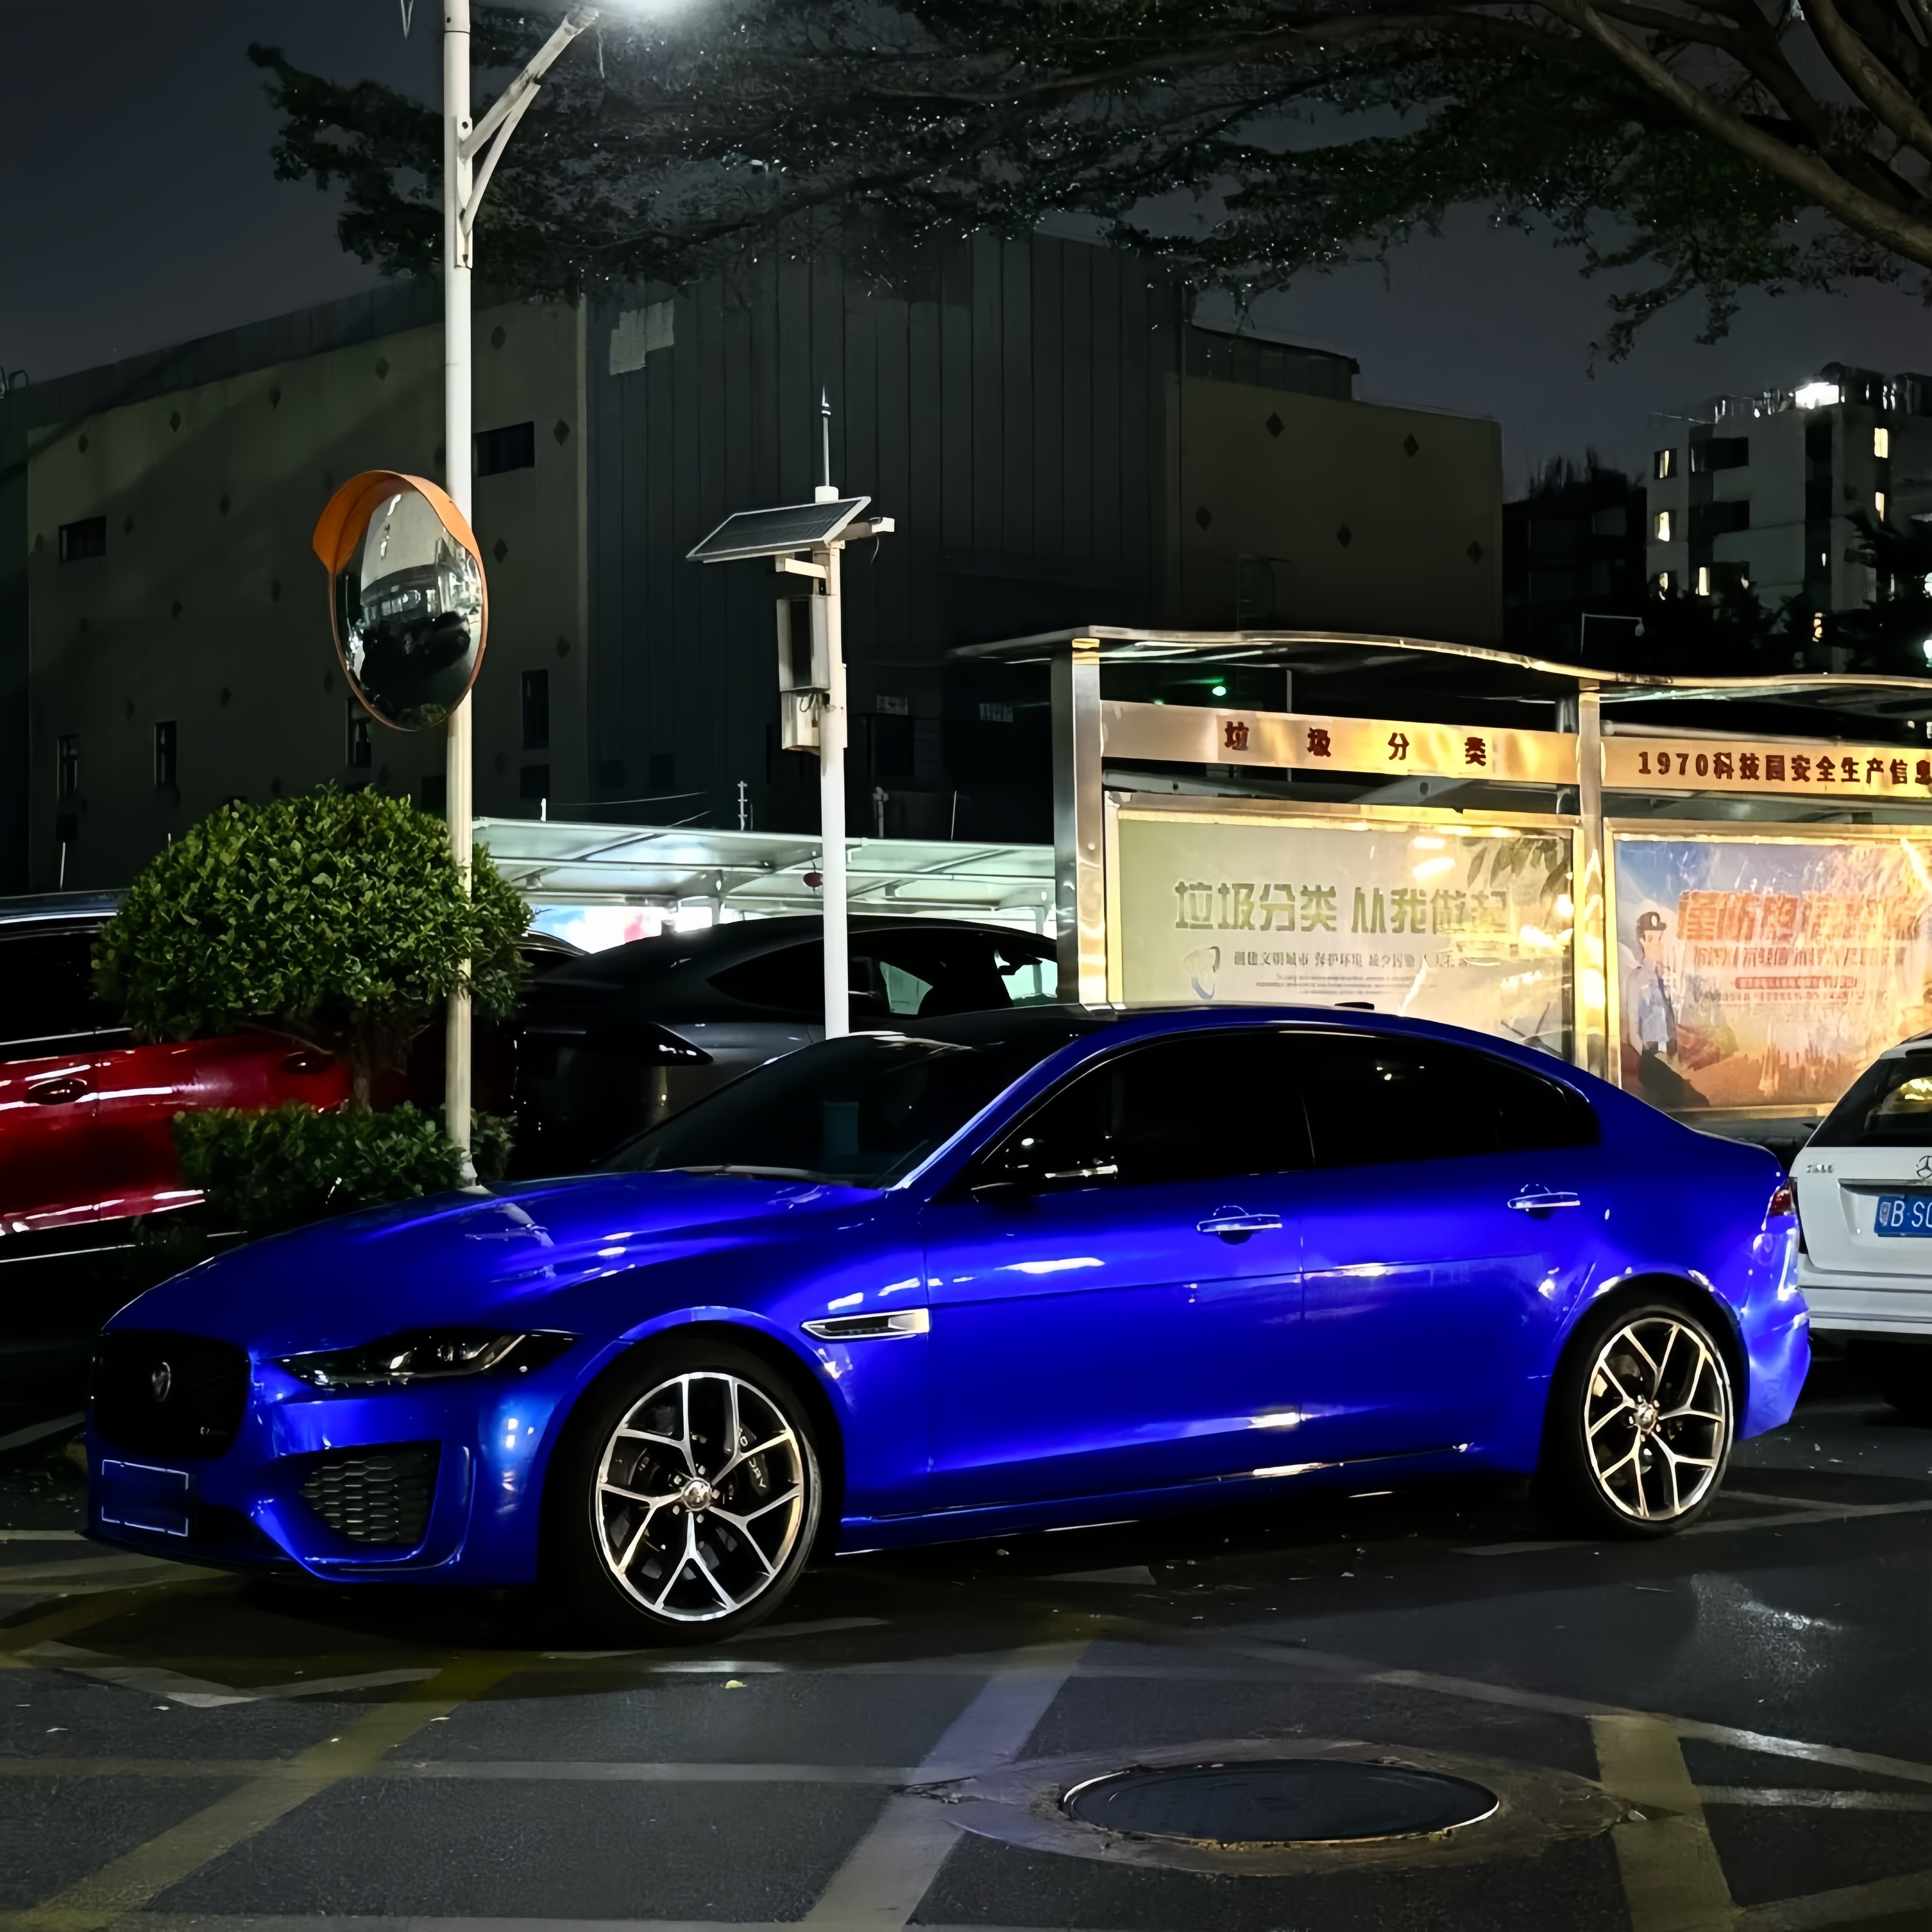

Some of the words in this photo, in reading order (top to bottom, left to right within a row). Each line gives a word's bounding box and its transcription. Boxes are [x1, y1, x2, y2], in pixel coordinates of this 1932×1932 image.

[1224, 721, 1486, 766] 垃圾分类
[1175, 881, 1337, 932] 垃圾分类
